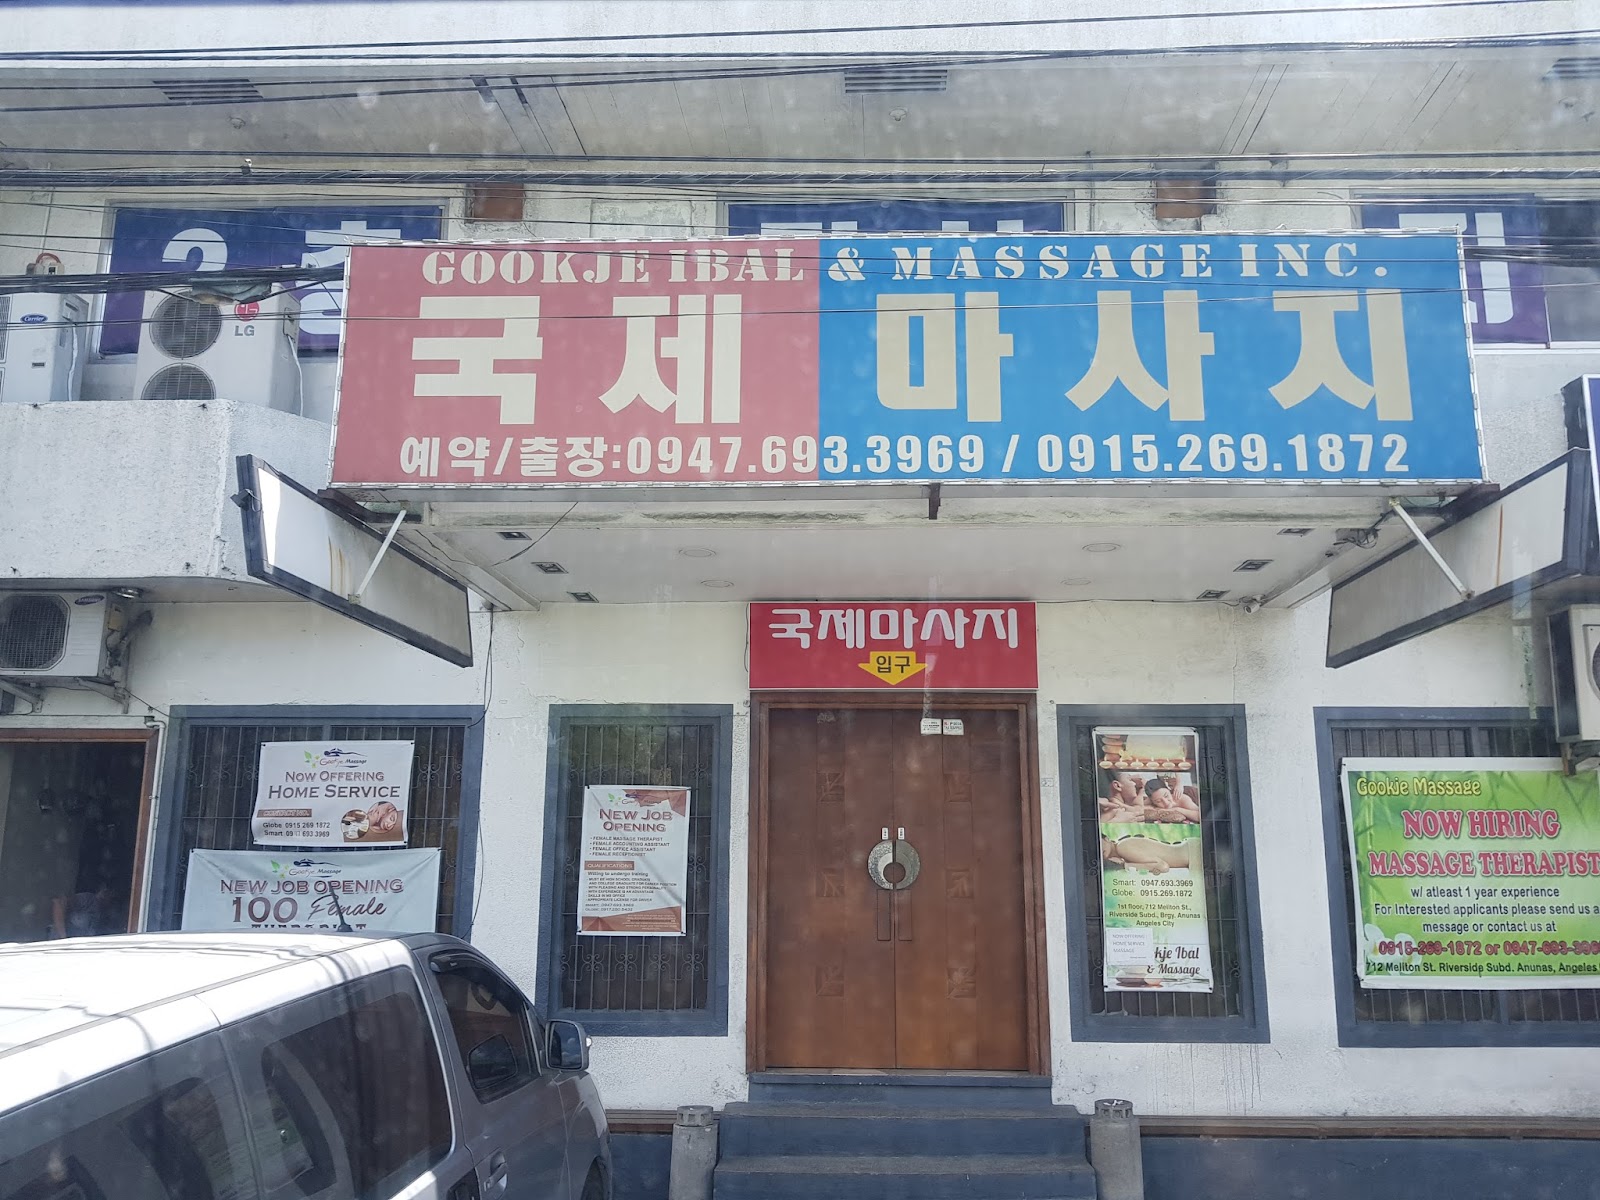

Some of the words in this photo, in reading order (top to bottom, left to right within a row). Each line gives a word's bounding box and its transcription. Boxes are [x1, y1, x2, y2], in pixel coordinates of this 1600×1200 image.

[422, 249, 649, 285] GOOKJE
[670, 248, 804, 283] IBAL
[828, 247, 866, 281] &
[892, 243, 1212, 281] MASSAGE
[1240, 242, 1387, 278] INC.
[234, 324, 255, 337] LG
[1038, 432, 1409, 474] 0915.269.1872
[769, 608, 1018, 649] 국제마사지
[876, 655, 911, 674] 입구
[320, 770, 385, 782] OFFERING
[268, 785, 320, 799] HOME
[324, 784, 401, 798] SERVICE
[1414, 778, 1482, 796] Massage
[599, 809, 639, 821] NEW
[641, 809, 673, 821] JOB
[603, 821, 667, 832] OPENING
[1401, 809, 1463, 839] NOW
[1467, 809, 1561, 839] HIRING
[1368, 851, 1476, 877] MASSAGE
[1478, 851, 1600, 876] THERAPIST
[317, 868, 342, 876] Massage
[220, 879, 268, 894] NEW
[271, 880, 309, 894] JOB
[314, 879, 404, 893] OPENING
[1112, 878, 1136, 886] Smart:
[1140, 879, 1194, 887] 0947.693.3969
[1111, 888, 1135, 897] Globe:
[1140, 889, 1193, 897] 0915.269.1872
[1411, 886, 1424, 898] w/
[1426, 886, 1463, 898] atleast
[1465, 886, 1471, 898] 1
[1474, 888, 1498, 900] year
[1501, 887, 1560, 900] experience
[232, 896, 298, 923] 100
[307, 894, 387, 920] Female
[1128, 903, 1144, 911] floor,
[1375, 903, 1393, 915] For
[1395, 903, 1450, 915] Interested
[1453, 903, 1509, 917] applicants
[1512, 904, 1547, 917] please
[1549, 903, 1576, 915] send
[1578, 905, 1590, 915] us
[1160, 912, 1176, 920] Brgy.
[1136, 920, 1161, 928] Angeles
[1162, 920, 1175, 928] City
[1422, 923, 1469, 935] message
[1472, 923, 1484, 933] or
[1487, 921, 1525, 933] contact
[1526, 922, 1543, 933] us
[1545, 921, 1557, 933] at
[1154, 946, 1173, 962] kje
[1175, 946, 1200, 959] Ibal
[1378, 940, 1482, 956] 0915-269-1872
[1484, 941, 1500, 955] or
[1503, 940, 1600, 956] 0947-693-396
[1147, 965, 1155, 974] &
[1158, 963, 1201, 977] Massage
[1366, 962, 1384, 972] 712
[1385, 962, 1421, 972] Meliton
[1423, 963, 1436, 973] St.
[1439, 962, 1484, 974] Riverside
[1486, 962, 1515, 973] Subd.
[1517, 963, 1556, 974] Anunas,
[1559, 962, 1598, 974] Angeles
